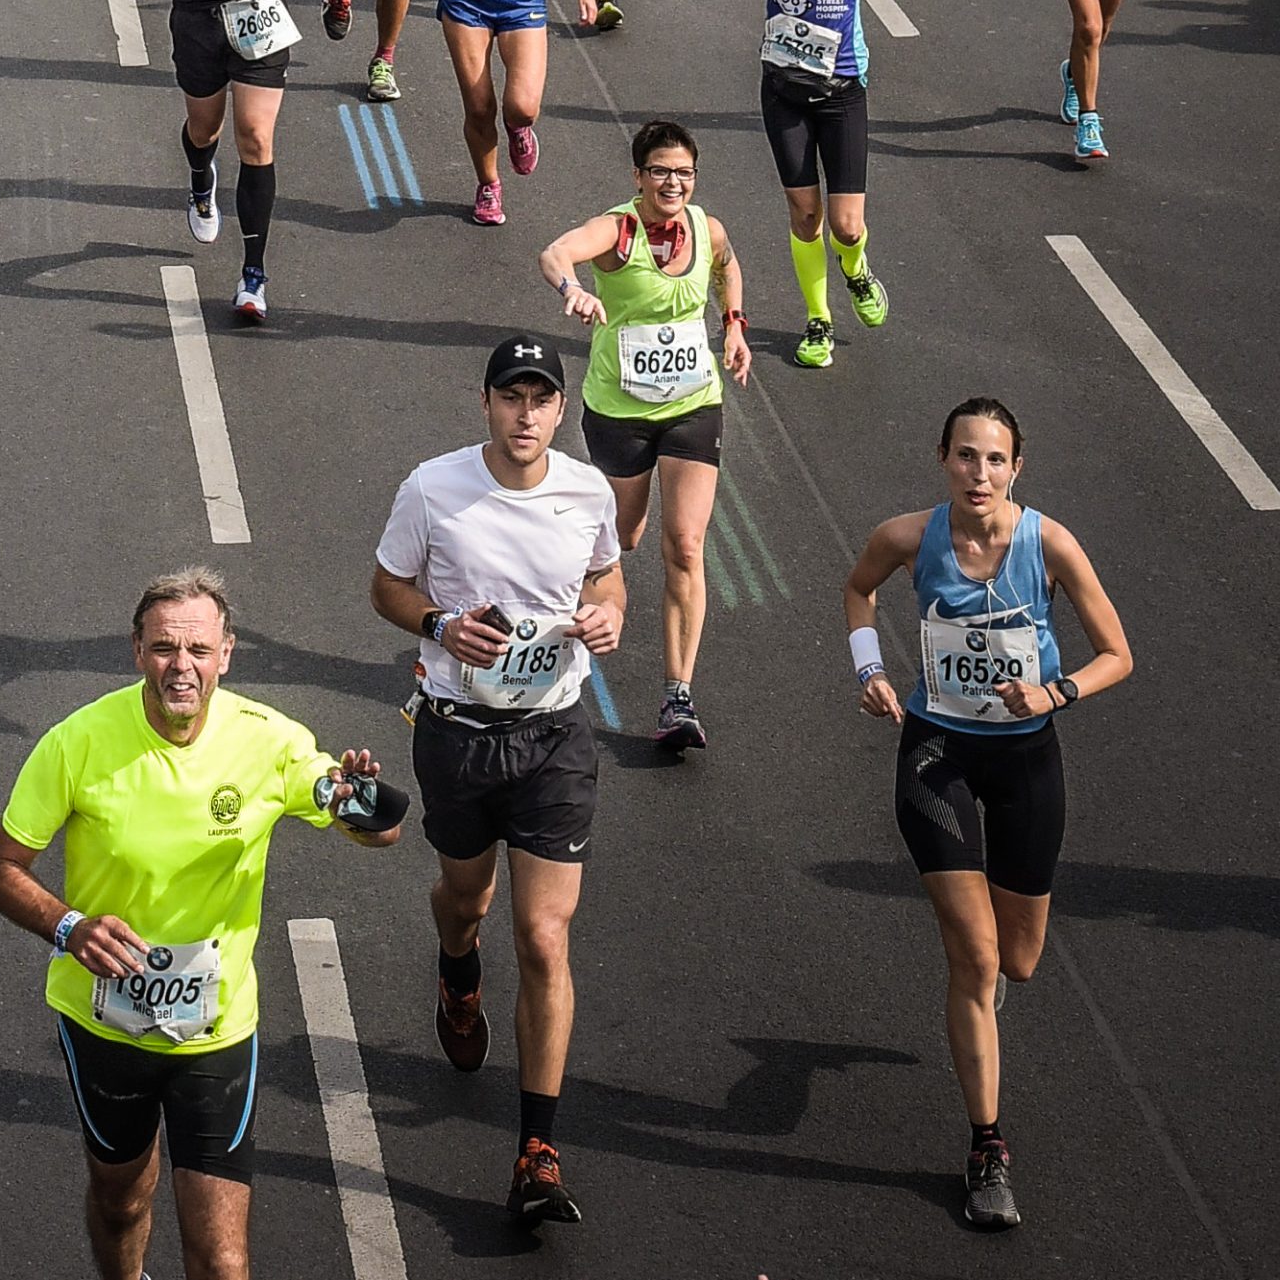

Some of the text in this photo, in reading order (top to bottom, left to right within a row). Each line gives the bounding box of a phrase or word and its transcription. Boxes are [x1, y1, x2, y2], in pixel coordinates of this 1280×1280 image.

[236, 5, 281, 38] 26086
[633, 346, 698, 375] 66269
[654, 375, 680, 384] Ariane
[501, 644, 560, 674] 1185
[939, 655, 1024, 684] 16529
[208, 827, 243, 837] LAUFSPORT
[115, 972, 204, 1009] 19005
[131, 1001, 173, 1021] Michael
